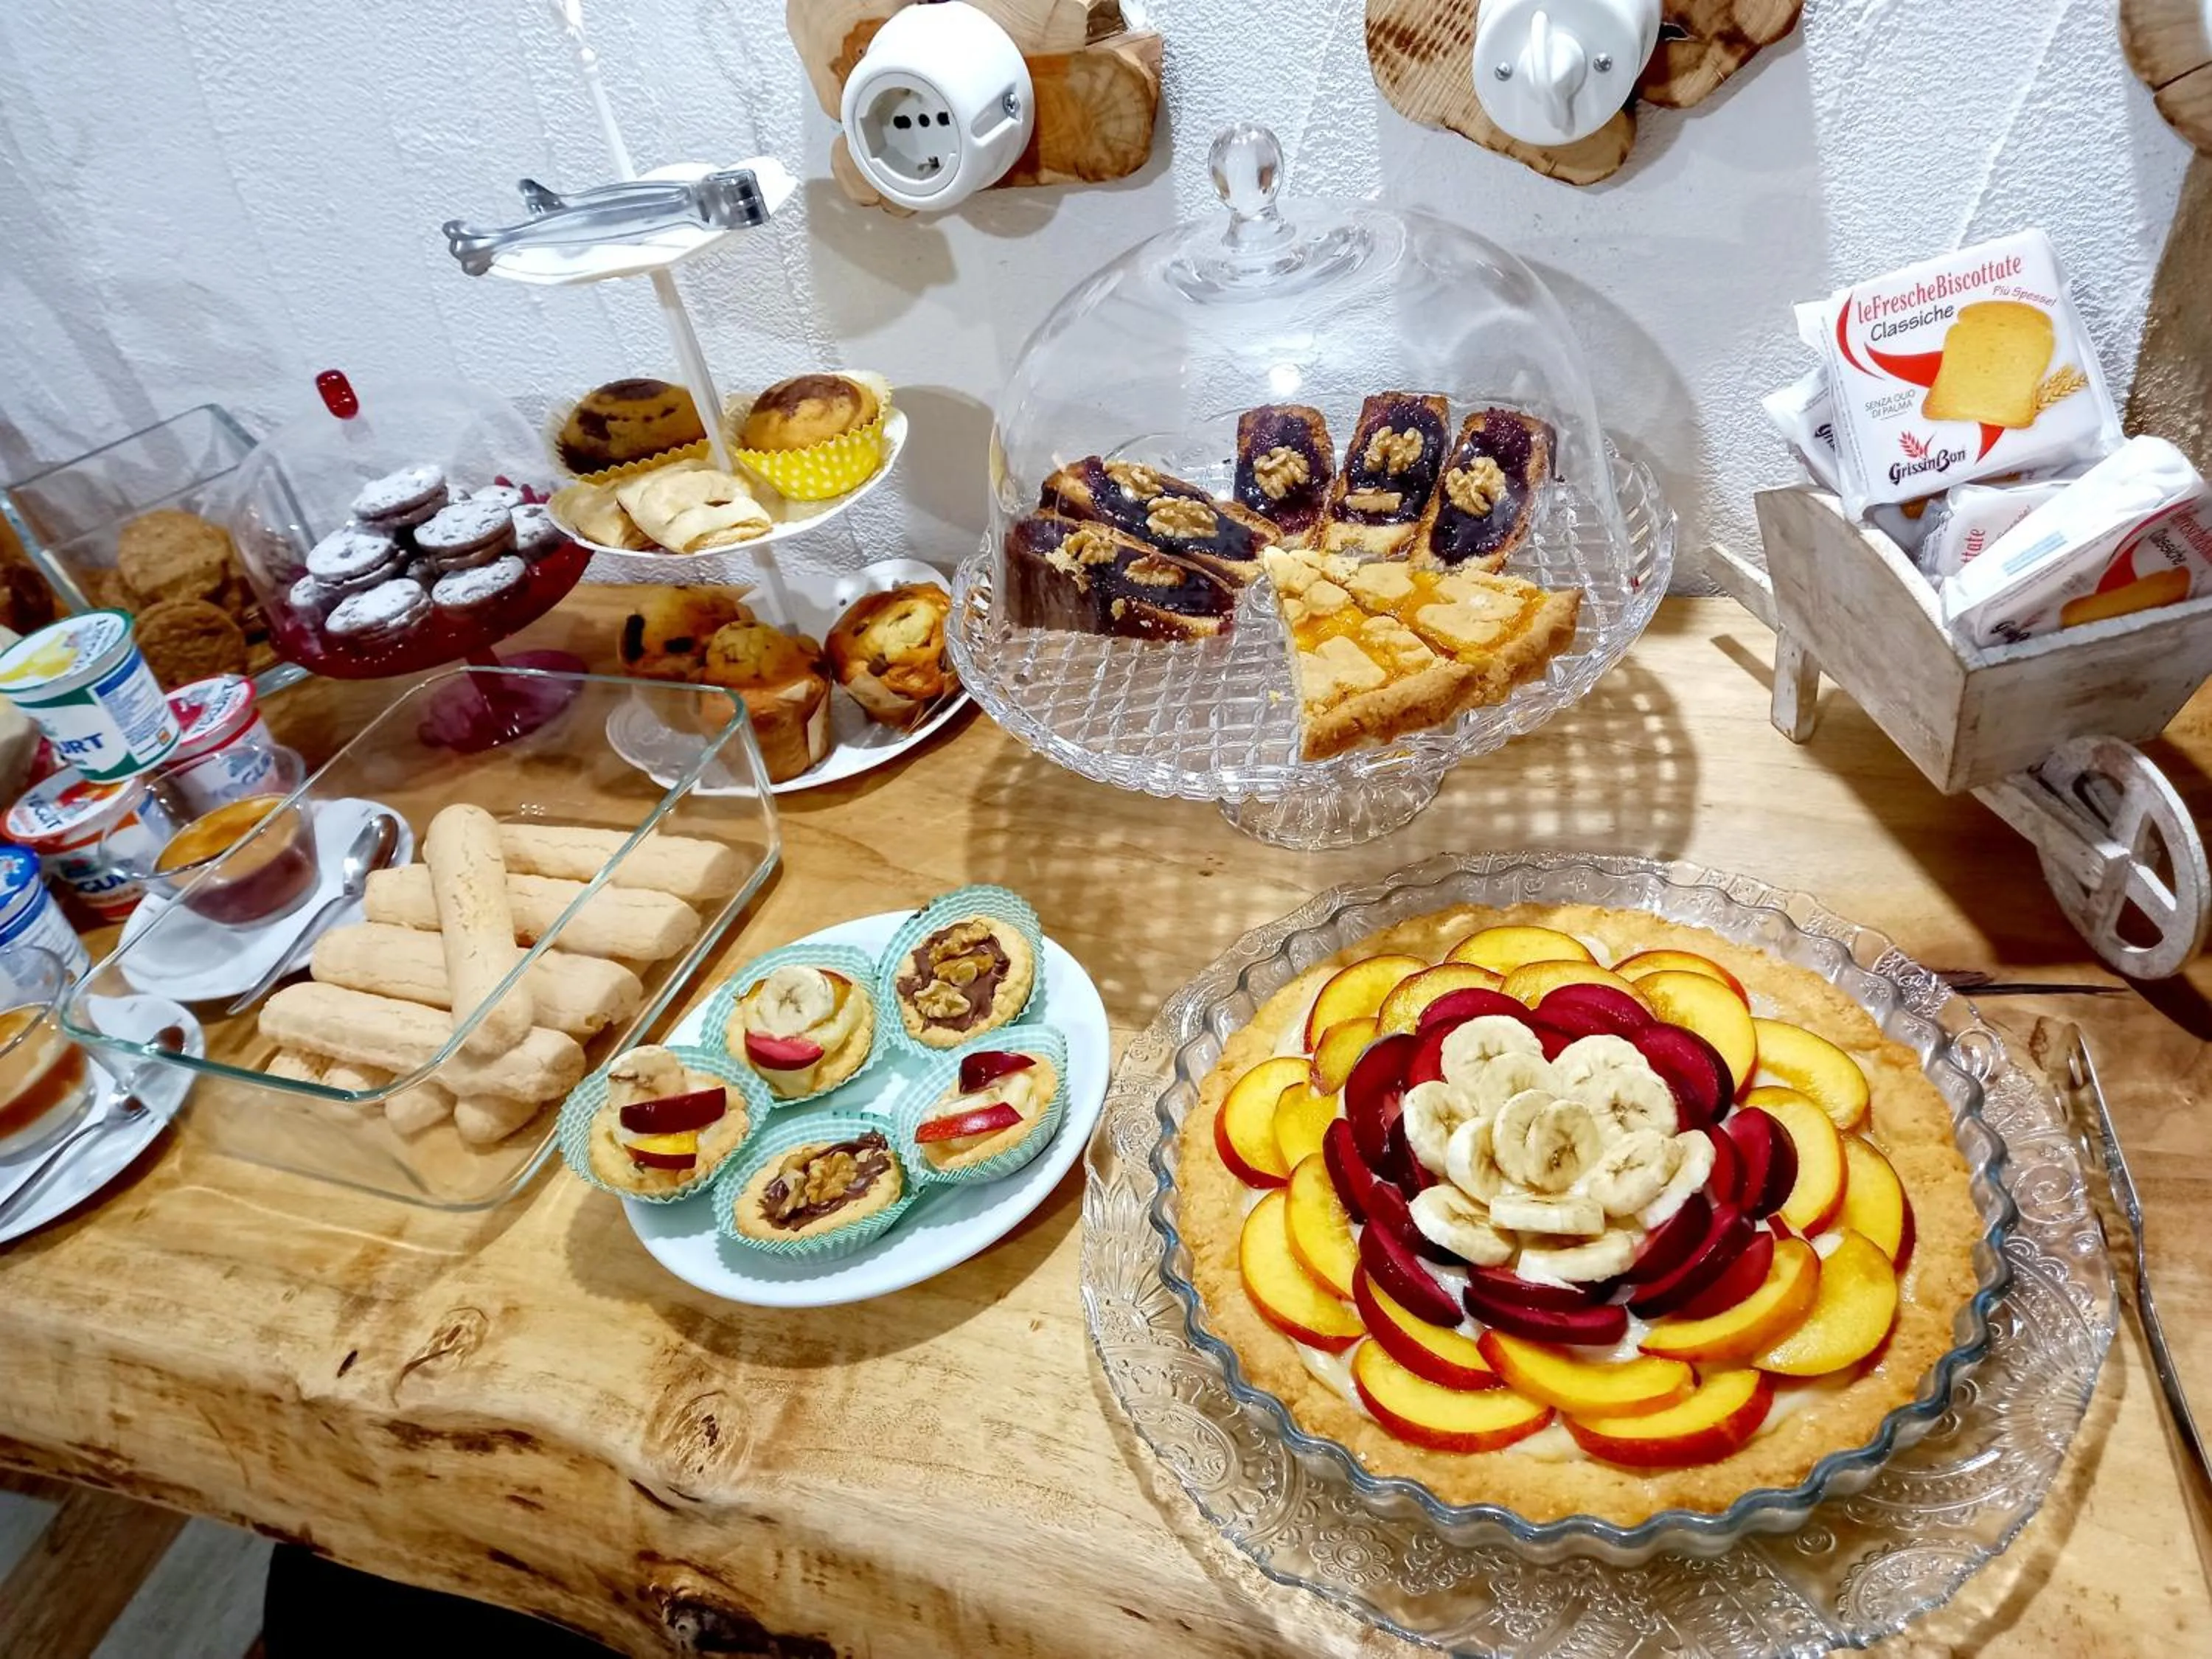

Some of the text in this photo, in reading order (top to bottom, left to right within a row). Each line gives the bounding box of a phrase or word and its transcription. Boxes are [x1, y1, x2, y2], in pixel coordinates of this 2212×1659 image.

[1871, 305, 1954, 341] Classiche
[1865, 389, 1916, 411] SENZA OLIO
[1871, 400, 1913, 419] DI PALMA
[1888, 448, 1966, 486] GrissinBon
[56, 732, 103, 754] URT
